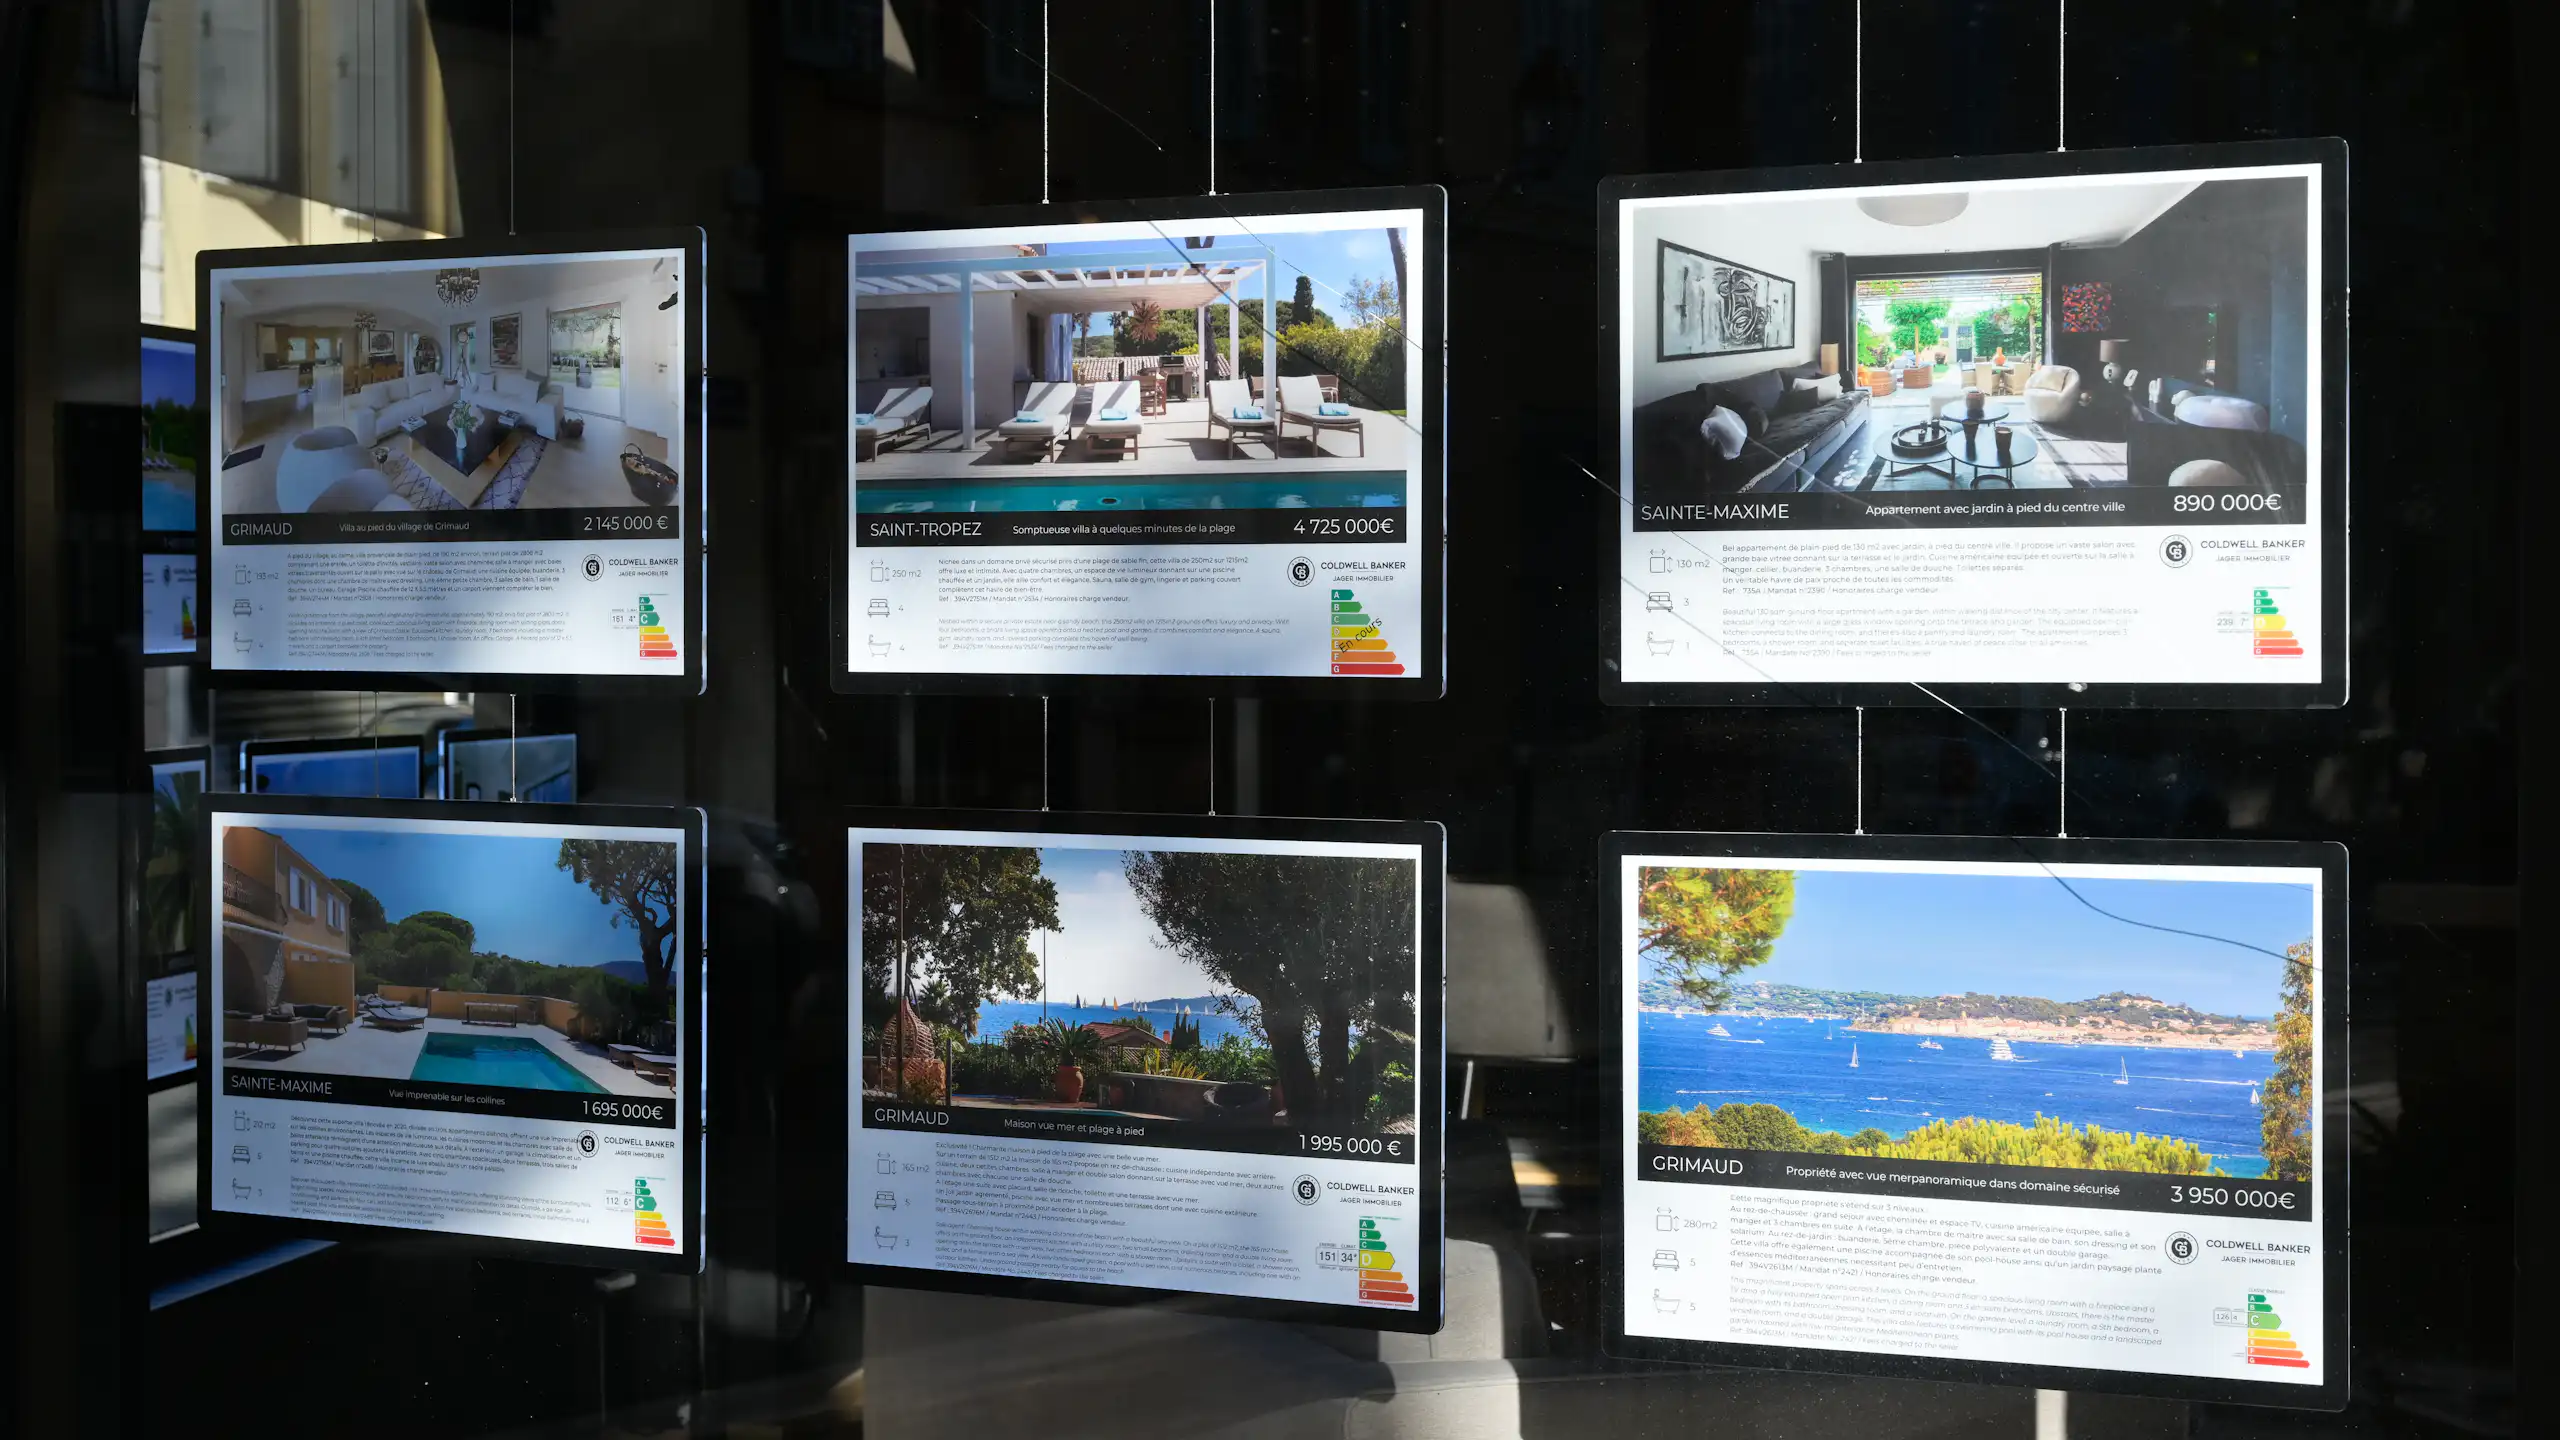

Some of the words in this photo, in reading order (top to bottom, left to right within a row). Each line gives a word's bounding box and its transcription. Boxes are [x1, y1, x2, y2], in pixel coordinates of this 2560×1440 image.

[1865, 504, 1941, 517] Appartement
[1943, 505, 1969, 514] avec
[1970, 502, 2004, 515] jardin
[2015, 502, 2041, 515] pied
[2061, 502, 2100, 512] centre
[2101, 501, 2125, 512] ville
[2173, 494, 2215, 512] 890
[2220, 493, 2281, 511] 000€
[1641, 503, 1789, 520] SAINTE-MAXIME
[230, 522, 293, 536] GRIMAUD
[338, 523, 355, 532] Villa
[366, 523, 384, 532] pied
[396, 521, 422, 533] village
[434, 521, 470, 530] Grimaud
[583, 516, 592, 531] 2
[595, 515, 619, 530] 145
[623, 515, 653, 530] 000
[656, 515, 668, 530] €
[870, 521, 982, 536] SAINT-TROPEZ
[1012, 525, 1071, 536] Somptueuse
[1071, 524, 1090, 534] villa
[1098, 523, 1142, 535] quelques
[1143, 523, 1183, 533] minutes
[1208, 523, 1236, 534] plage
[1293, 518, 1306, 534] 4
[1309, 518, 1340, 534] 725
[1344, 517, 1394, 534] 000€
[2200, 539, 2258, 549] COLDWELL
[2262, 539, 2305, 548] BANKER
[608, 558, 647, 566] COLDWELL
[649, 557, 679, 565] BANKER
[1676, 558, 1692, 568] 130
[2243, 554, 2291, 562] IMMOBILIER
[1320, 561, 1368, 570] COLDWELL
[1370, 561, 1406, 569] BANKER
[891, 569, 907, 578] 250
[1338, 640, 1354, 654] En
[1355, 617, 1383, 642] cours
[231, 1074, 332, 1095] SAINTE-MAXIME
[388, 1088, 404, 1098] Vue
[405, 1089, 450, 1101] imprenable
[450, 1094, 463, 1102] sur
[463, 1093, 476, 1103] les
[475, 1095, 506, 1105] collines
[582, 1100, 588, 1115] 1
[591, 1100, 618, 1117] 695
[621, 1103, 663, 1120] 000€
[874, 1107, 949, 1125] GRIMAUD
[1004, 1118, 1036, 1129] Maison
[1037, 1122, 1055, 1130] vue
[1056, 1123, 1075, 1131] mer
[1088, 1123, 1115, 1136] plage
[1123, 1125, 1145, 1137] pied
[603, 1136, 643, 1146] COLDWELL
[644, 1139, 675, 1148] BANKER
[1299, 1134, 1305, 1150] 1
[1310, 1134, 1342, 1152] 995
[1346, 1137, 1382, 1154] 000
[1386, 1140, 1401, 1156] €
[632, 1151, 664, 1159] IMMOBILIER
[936, 1141, 967, 1150] Exclusivité
[972, 1144, 1006, 1152] Charmante
[1036, 1148, 1051, 1156] pied
[1068, 1151, 1086, 1159] plage
[902, 1162, 915, 1172] 165
[1652, 1155, 1743, 1175] GRIMAUD
[1326, 1181, 1376, 1193] COLDWELL
[1377, 1184, 1415, 1195] BANKER
[1786, 1166, 1836, 1178] Propriété
[1838, 1170, 1864, 1180] avec
[1865, 1172, 1887, 1181] vue
[1888, 1173, 1987, 1189] merpanoramique
[1988, 1177, 2017, 1189] dans
[2018, 1179, 2071, 1192] domaine
[2072, 1182, 2120, 1197] sécurisé
[605, 1196, 619, 1205] 112
[1339, 1196, 1361, 1204] JAGER
[1362, 1198, 1402, 1207] IMMOBILIER
[1753, 1196, 1799, 1206] magnifique
[2170, 1185, 2183, 1203] 3
[2188, 1186, 2228, 1205] 950
[2234, 1189, 2295, 1209] 000€
[1683, 1218, 1718, 1230] 280m2
[2205, 1239, 2264, 1251] COLDWELL
[2267, 1243, 2311, 1254] BANKER
[1319, 1251, 1336, 1261] 151
[1361, 1254, 1372, 1266] D
[2221, 1255, 2247, 1263] JAGER
[2248, 1257, 2296, 1266] IMMOBILIER
[2251, 1315, 2260, 1326] C
